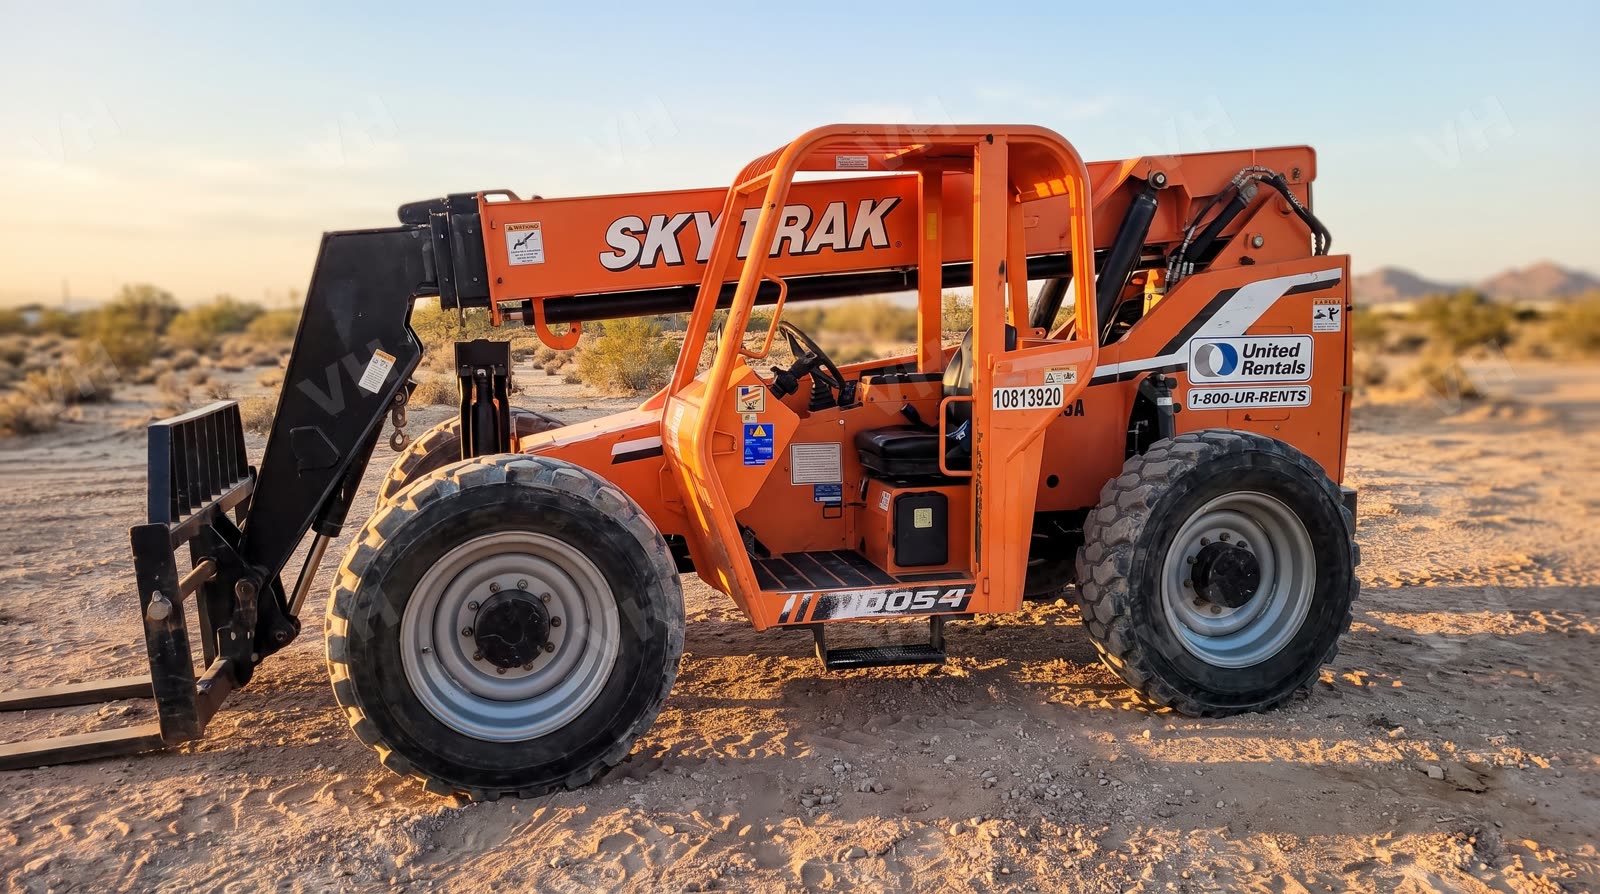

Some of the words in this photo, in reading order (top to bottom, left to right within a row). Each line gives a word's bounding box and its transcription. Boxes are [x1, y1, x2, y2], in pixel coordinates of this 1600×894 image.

[1242, 342, 1301, 358] United
[1241, 360, 1306, 376] Rentals
[994, 387, 1061, 408] 10813920
[1192, 390, 1306, 404] 1-800-UR-RENTS
